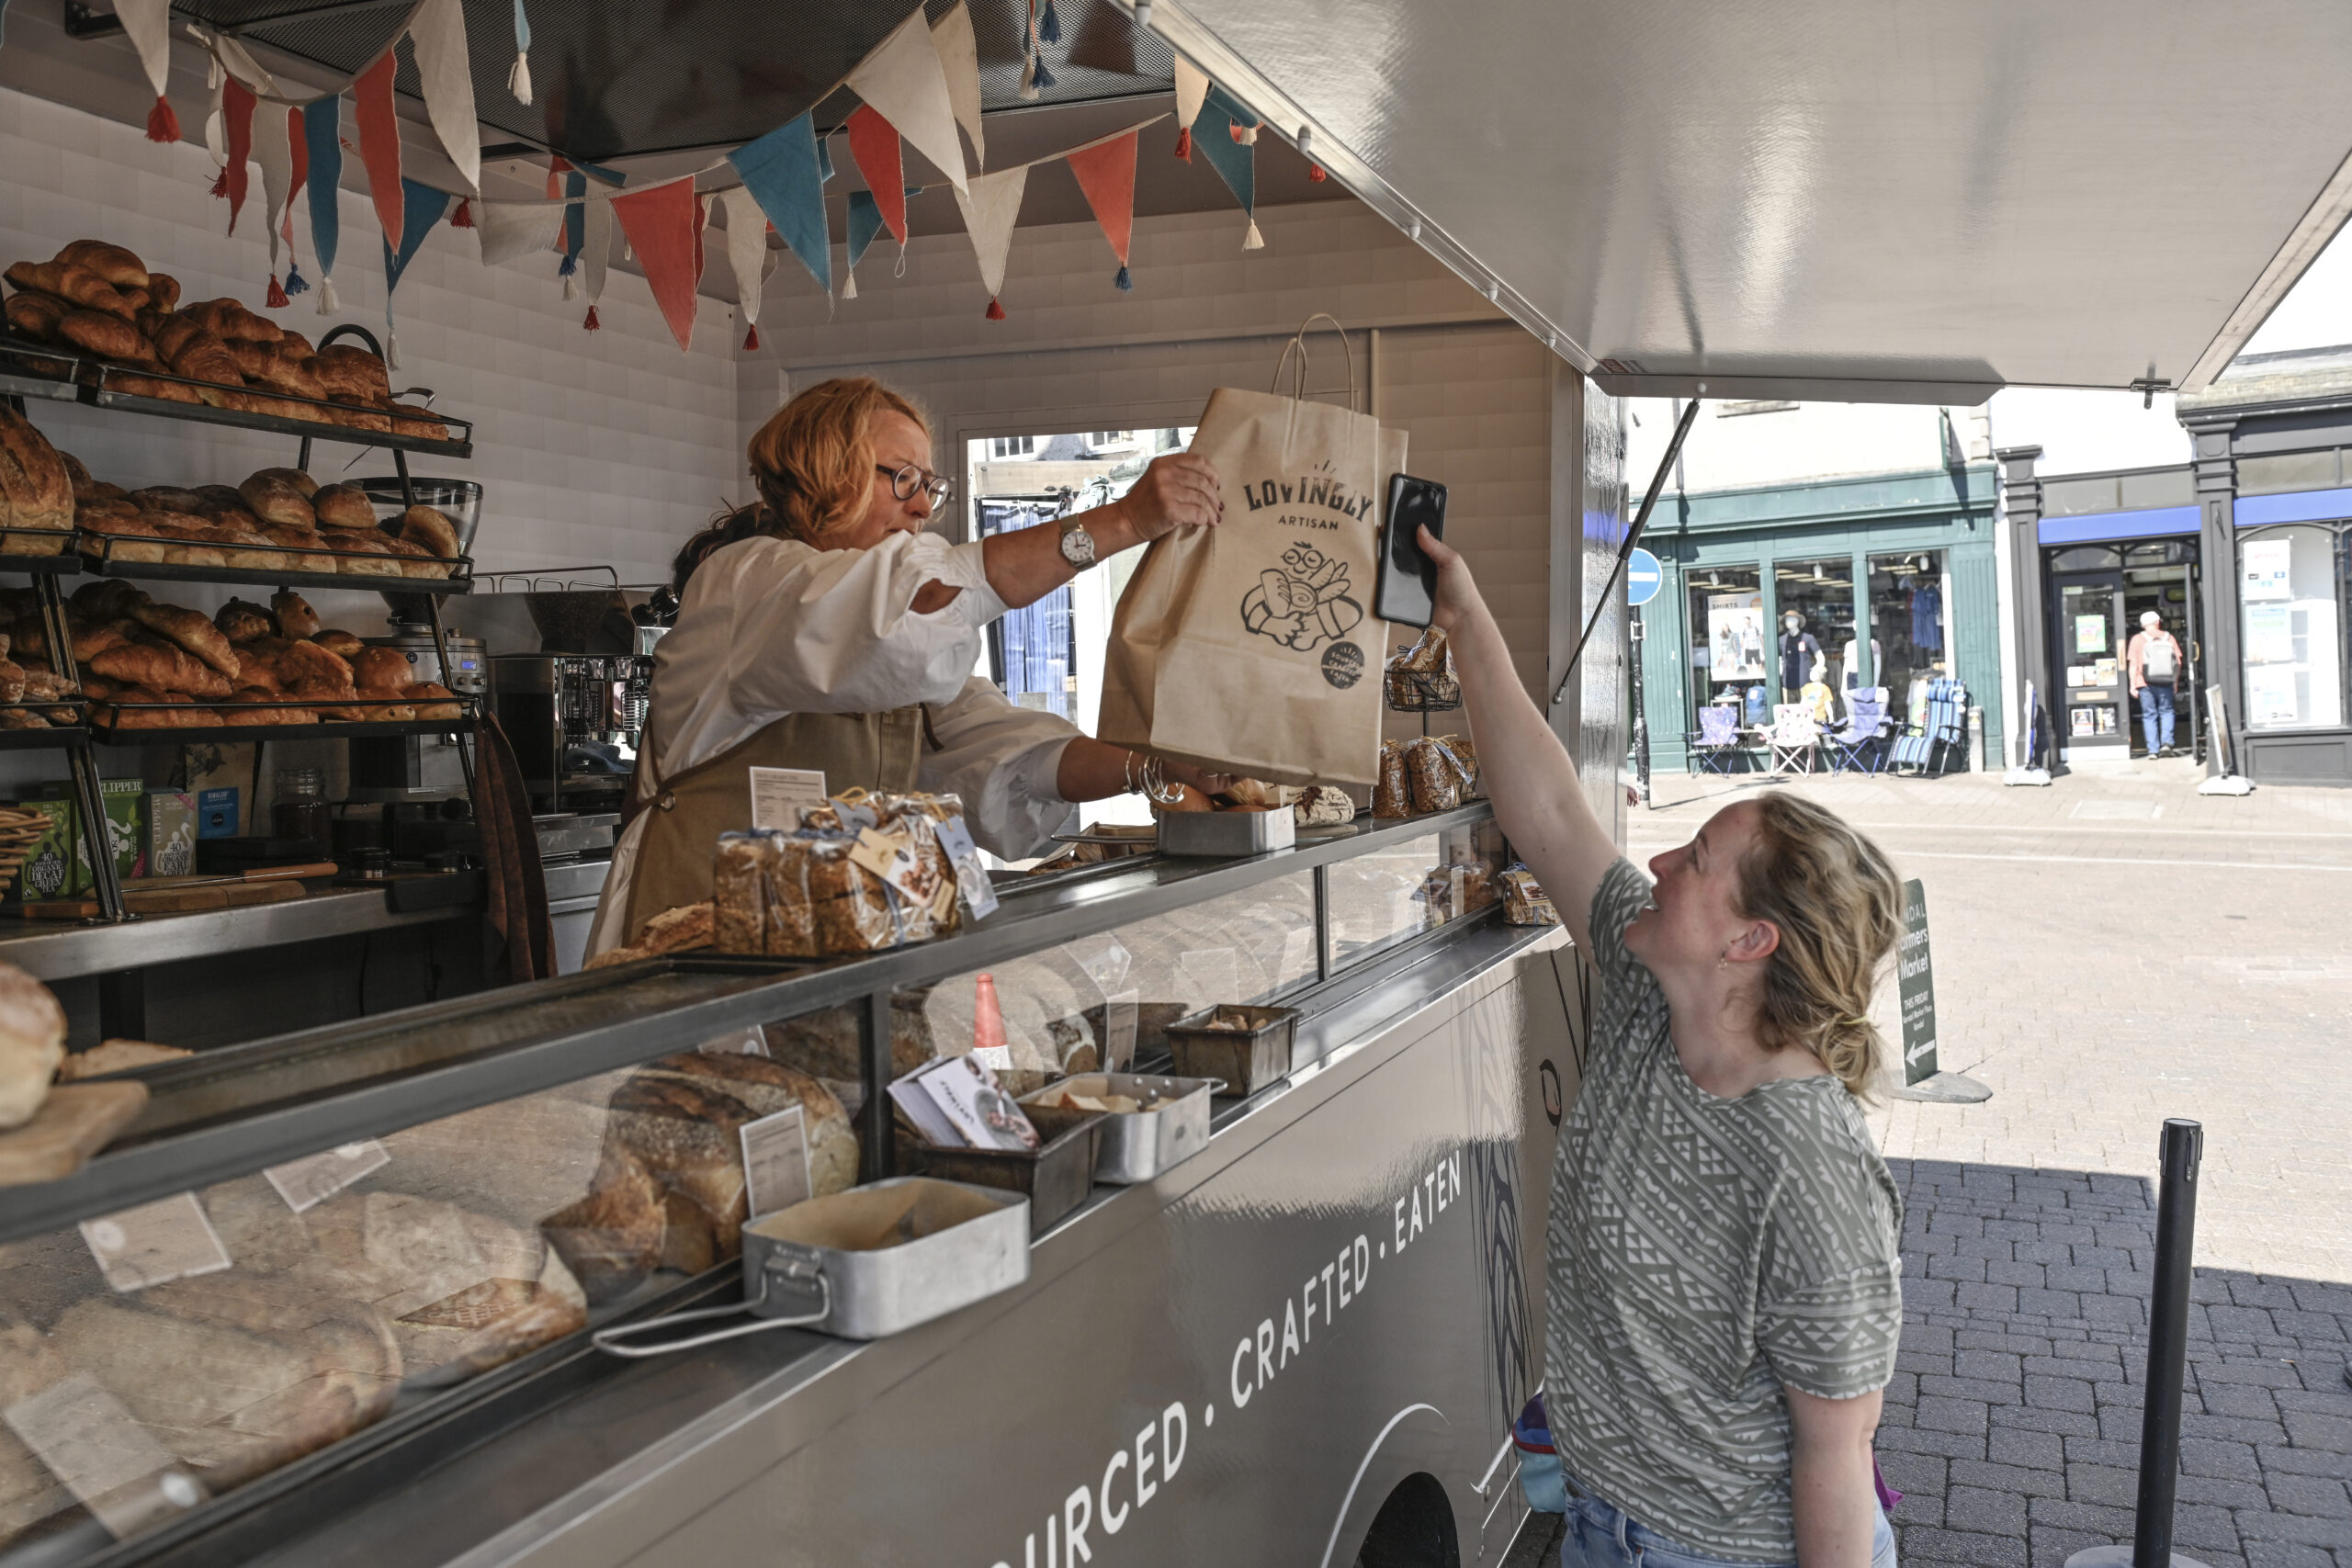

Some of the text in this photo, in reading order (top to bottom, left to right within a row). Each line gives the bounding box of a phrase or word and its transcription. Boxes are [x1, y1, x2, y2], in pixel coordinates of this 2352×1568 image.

[1243, 476, 1374, 522] LOVINGLY
[1278, 514, 1339, 531] ARTISAN
[1712, 602, 1738, 610] SHIRTS
[170, 842, 182, 852] 40
[42, 852, 53, 862] 40
[31, 864, 63, 874] ORGANIC
[164, 861, 189, 871] EARL
[31, 870, 64, 882] DECAF
[34, 878, 62, 888] GREEN
[42, 886, 56, 894] TEA
[1903, 903, 1927, 923] NDAL
[1899, 928, 1928, 952] armers
[1900, 952, 1928, 980] Market
[1904, 997, 1914, 1010] THIS
[989, 1150, 1461, 1568] URCED CRAFTED EATEN
